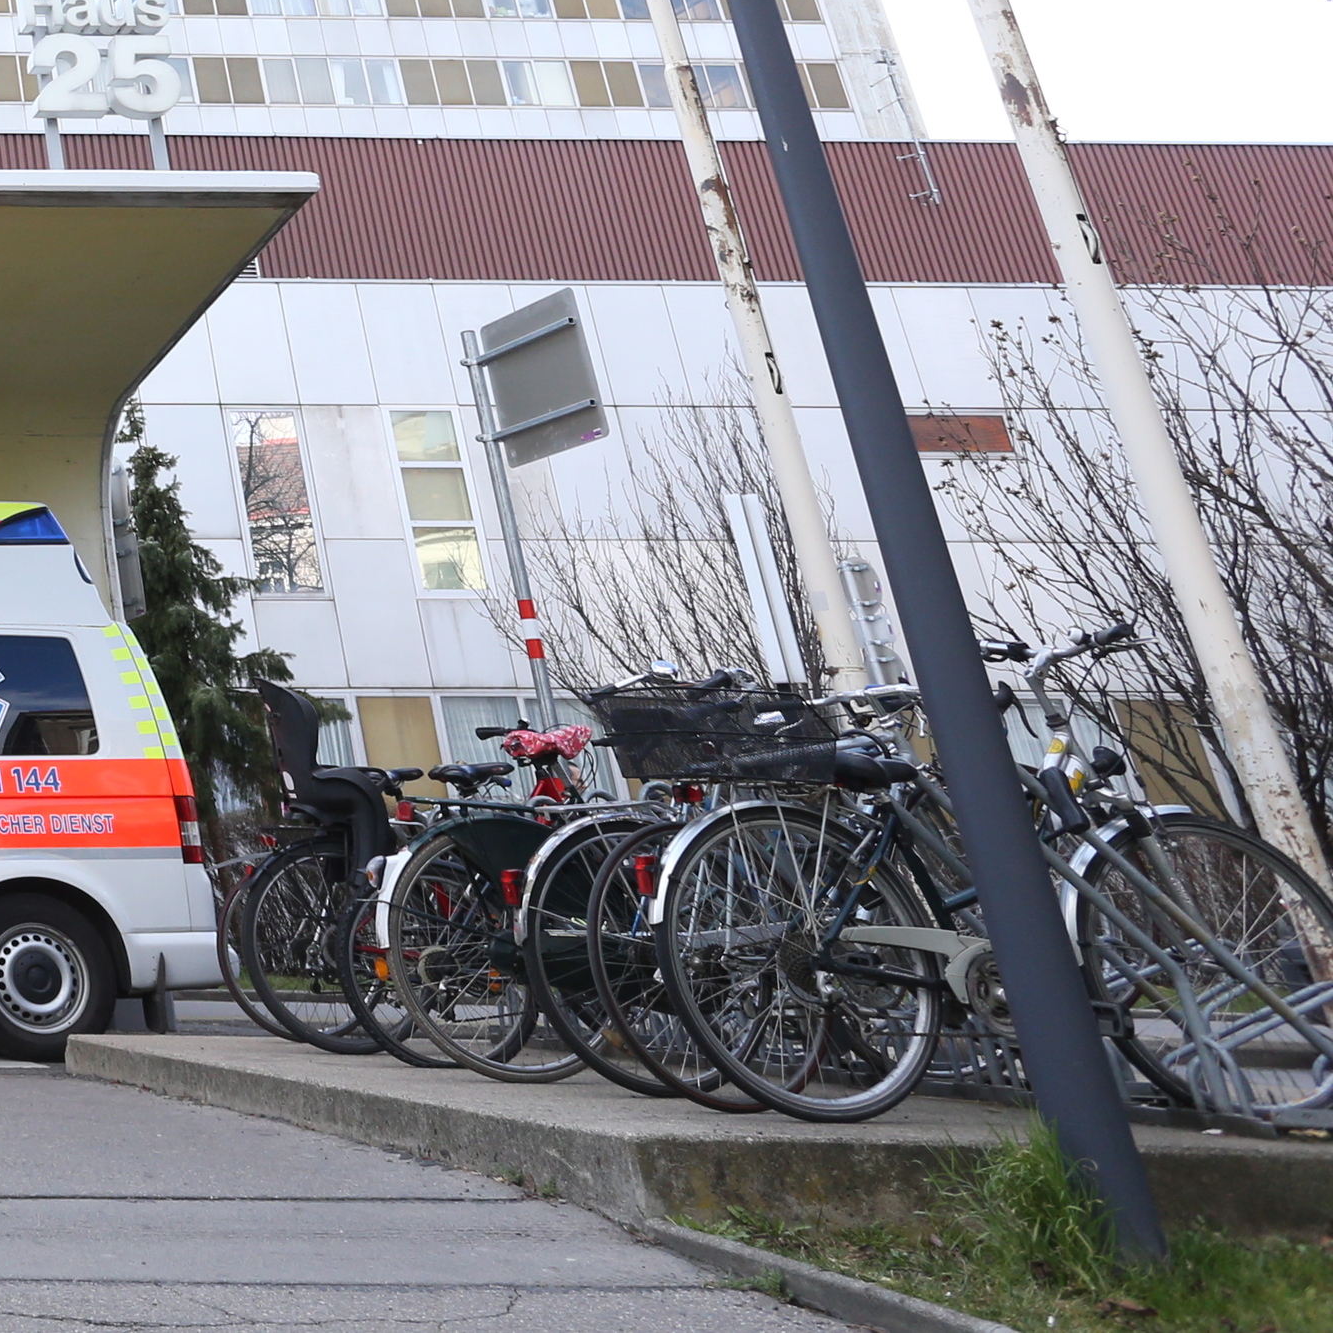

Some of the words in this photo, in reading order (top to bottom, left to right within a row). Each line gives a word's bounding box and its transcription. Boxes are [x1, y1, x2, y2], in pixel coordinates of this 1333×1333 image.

[27, 33, 181, 120] 25
[11, 766, 63, 793] 144
[50, 813, 114, 834] DIENST
